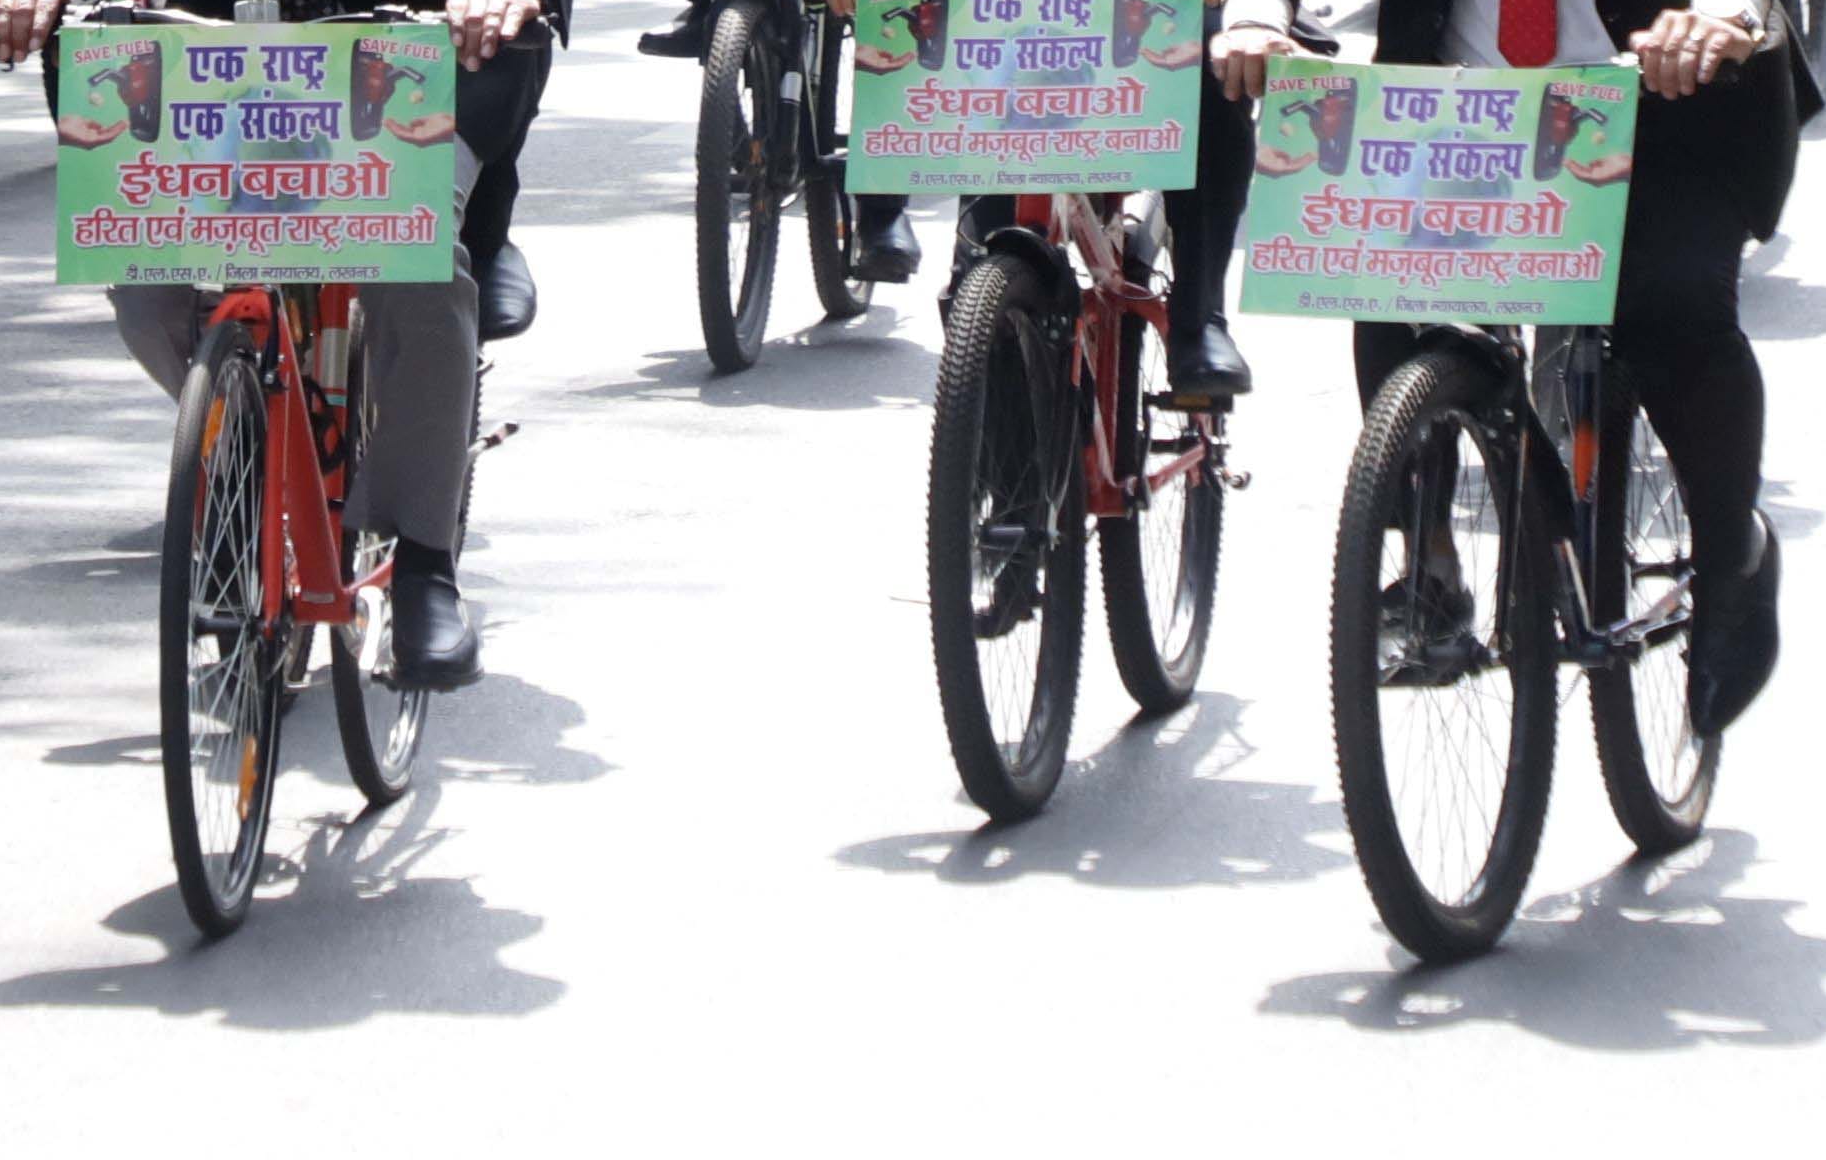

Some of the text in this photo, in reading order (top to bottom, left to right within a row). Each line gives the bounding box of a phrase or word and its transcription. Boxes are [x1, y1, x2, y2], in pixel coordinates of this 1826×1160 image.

[74, 41, 154, 64] SAVE FUEL
[188, 46, 327, 89] एक राष्ट्र
[361, 39, 440, 60] SAVE FUEL
[954, 28, 1105, 69] एक संकल्प
[1014, 77, 1145, 117] बचाओ
[1269, 78, 1306, 92] SAVE
[1551, 82, 1586, 96] SAVE
[169, 90, 342, 140] एक संकल्प
[1382, 87, 1519, 131] एक राष्ट्र
[865, 124, 921, 155] हरित
[928, 123, 963, 155] एवं
[1053, 130, 1103, 158] राष्ट्र
[1105, 121, 1181, 152] बनाओ
[1359, 131, 1527, 180] एक संकल्प
[242, 152, 391, 199] बचाओ
[74, 208, 139, 246] हरित
[146, 207, 185, 245] एवं
[286, 214, 340, 251] राष्ट्र
[346, 207, 436, 242] बनाओ
[1423, 191, 1565, 236] बचाओ
[1252, 237, 1315, 273] हरित
[1323, 240, 1364, 276] एवं
[1460, 249, 1517, 284] राष्ट्र
[1518, 243, 1603, 280] बनाओ
